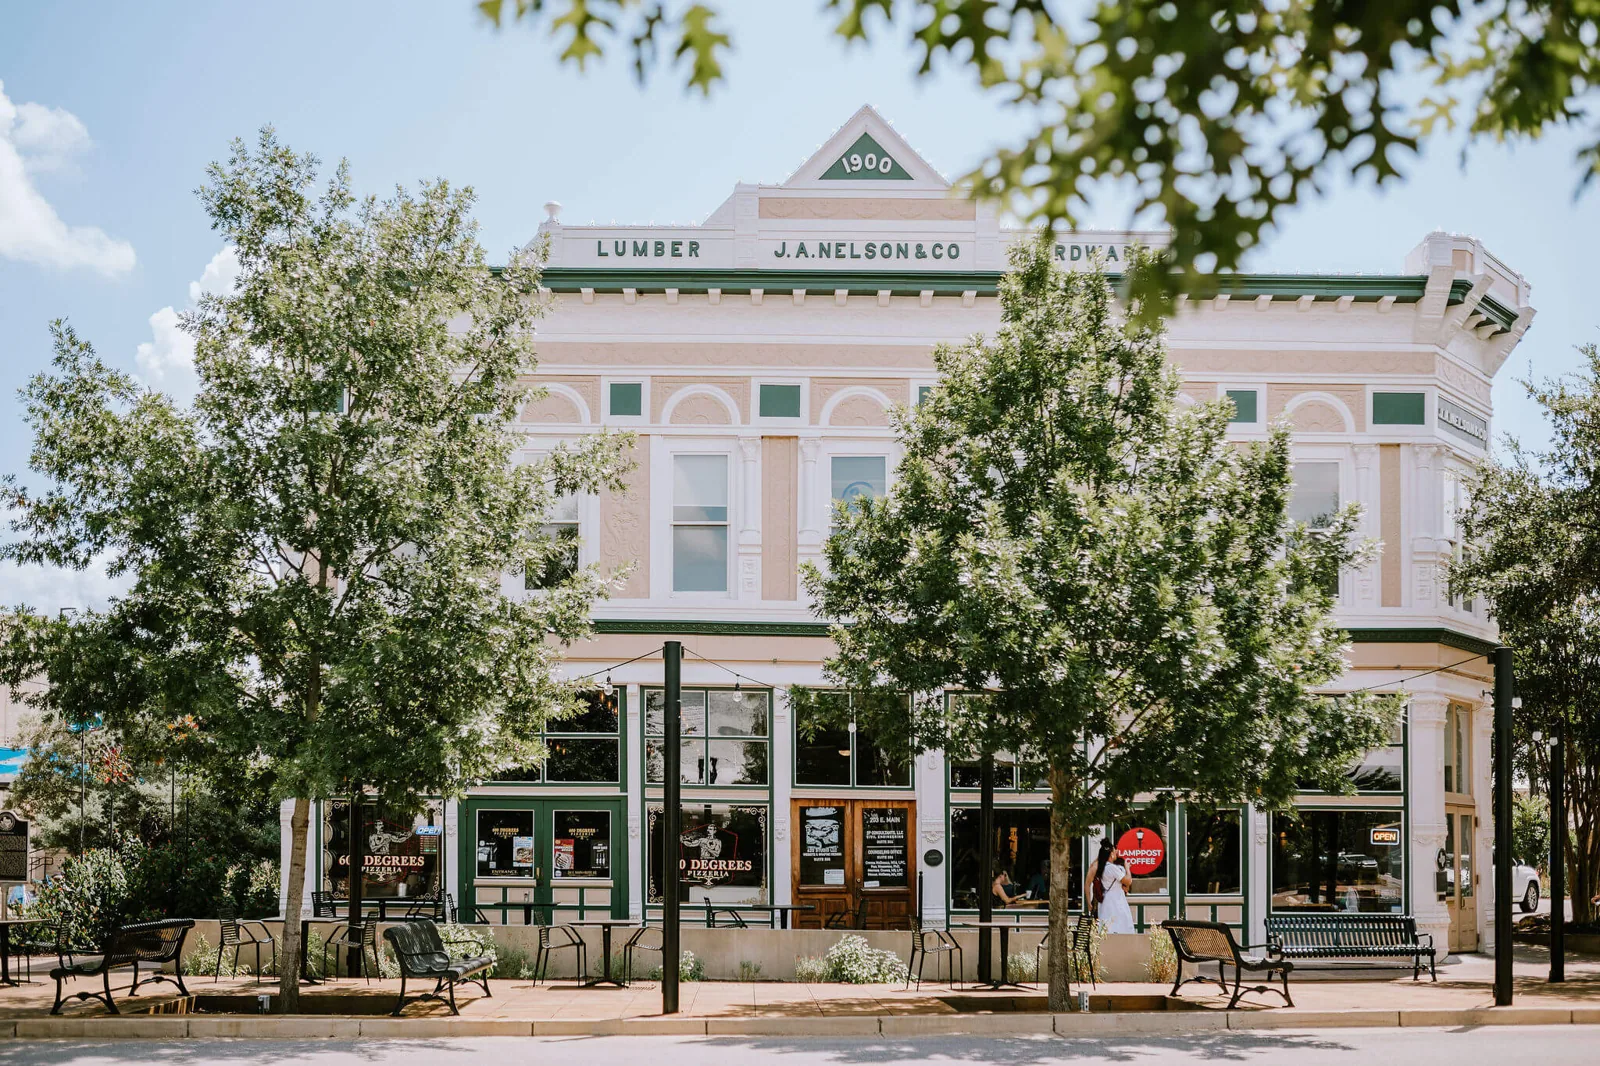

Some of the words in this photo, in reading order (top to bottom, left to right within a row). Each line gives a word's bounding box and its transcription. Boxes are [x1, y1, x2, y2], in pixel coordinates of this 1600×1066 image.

[842, 153, 892, 174] 1900
[597, 240, 700, 258] LUMBER
[417, 826, 441, 834] OPEN
[1373, 832, 1397, 841] OPEN
[1118, 849, 1162, 857] LAMPPOST
[363, 855, 425, 866] DEGREES
[691, 859, 752, 871] DEGREES
[1125, 857, 1156, 865] COFFEE
